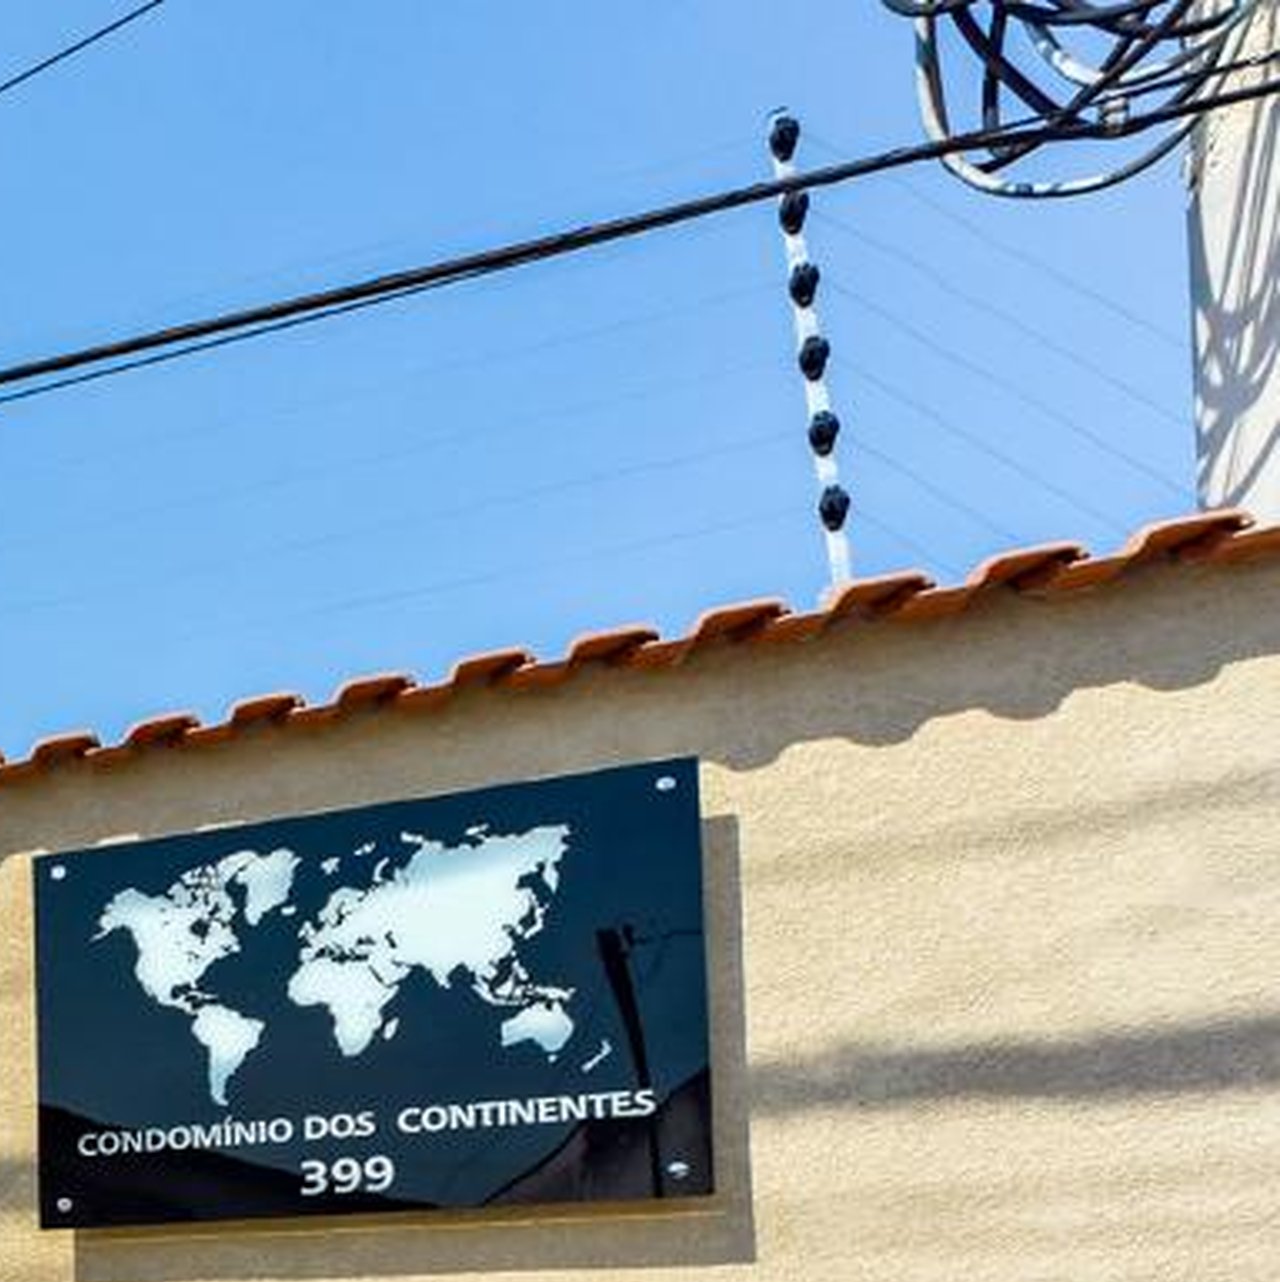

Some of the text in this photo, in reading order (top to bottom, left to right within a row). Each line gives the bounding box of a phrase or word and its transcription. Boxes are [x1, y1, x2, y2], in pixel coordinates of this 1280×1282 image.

[78, 1088, 658, 1158] CONDOMÍNIO DOS CONTINENTES
[299, 1154, 396, 1197] 399
